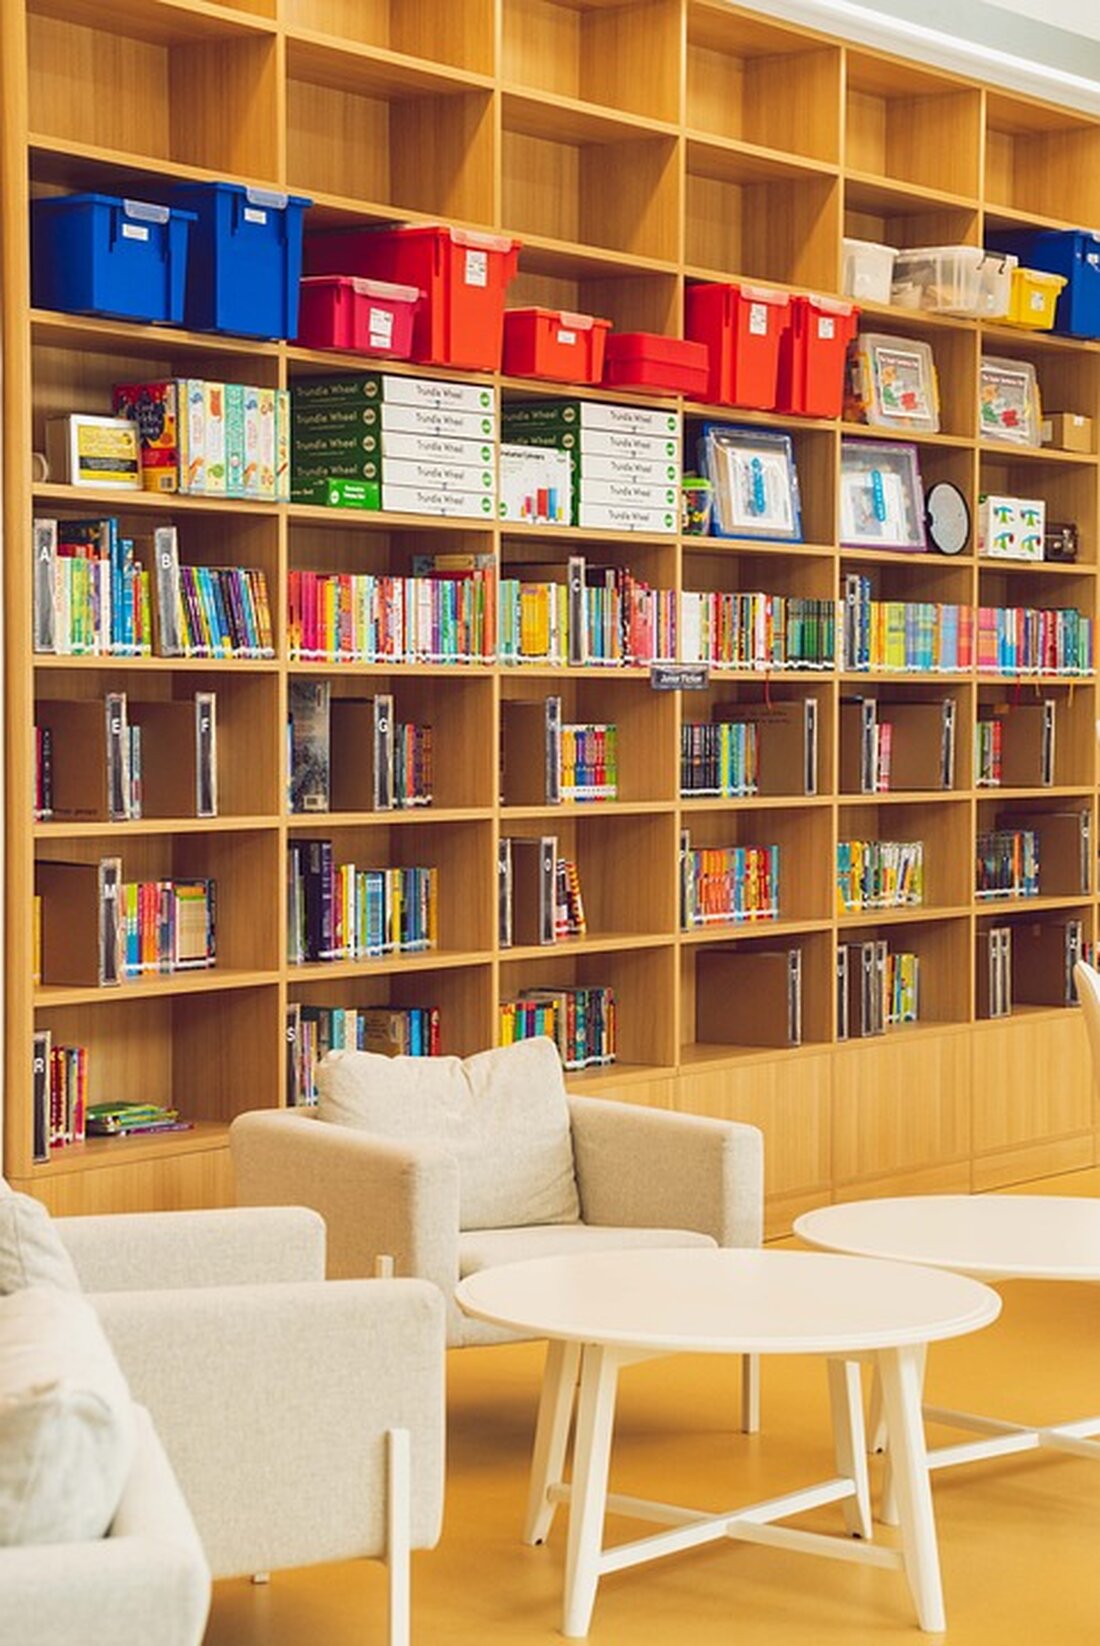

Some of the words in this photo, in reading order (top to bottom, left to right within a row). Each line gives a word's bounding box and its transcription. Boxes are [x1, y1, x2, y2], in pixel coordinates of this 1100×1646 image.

[330, 384, 358, 394] Wheel
[416, 384, 442, 396] Trundle
[443, 387, 463, 399] Wheel
[329, 411, 358, 422] Wheel
[416, 412, 442, 423] Trundle
[443, 415, 463, 427] Wheel
[531, 409, 558, 420] Wheel
[610, 411, 632, 422] Trundle
[633, 413, 652, 424] Wheel
[329, 437, 358, 448] Wheel
[417, 440, 442, 451] Trundle
[443, 443, 464, 454] Wheel
[610, 436, 632, 448] Trundle
[633, 439, 652, 449] Wheel
[330, 464, 358, 475] Wheel
[417, 466, 442, 478] Trundle
[443, 469, 465, 480] Wheel
[611, 461, 632, 472] Trundle
[633, 463, 652, 474] Wheel
[610, 485, 632, 497] Trundle
[633, 487, 652, 498] Wheel
[417, 492, 442, 503] Trundle
[443, 495, 465, 506] Wheel
[608, 509, 631, 521] Trundle
[631, 512, 650, 522] Wheel
[40, 546, 50, 562] A
[161, 553, 171, 569] B
[573, 578, 580, 592] C
[111, 718, 121, 734] E
[201, 718, 209, 733] F
[379, 718, 388, 733] G
[104, 884, 116, 900] M
[287, 1027, 296, 1042] S
[34, 1057, 44, 1073] R
